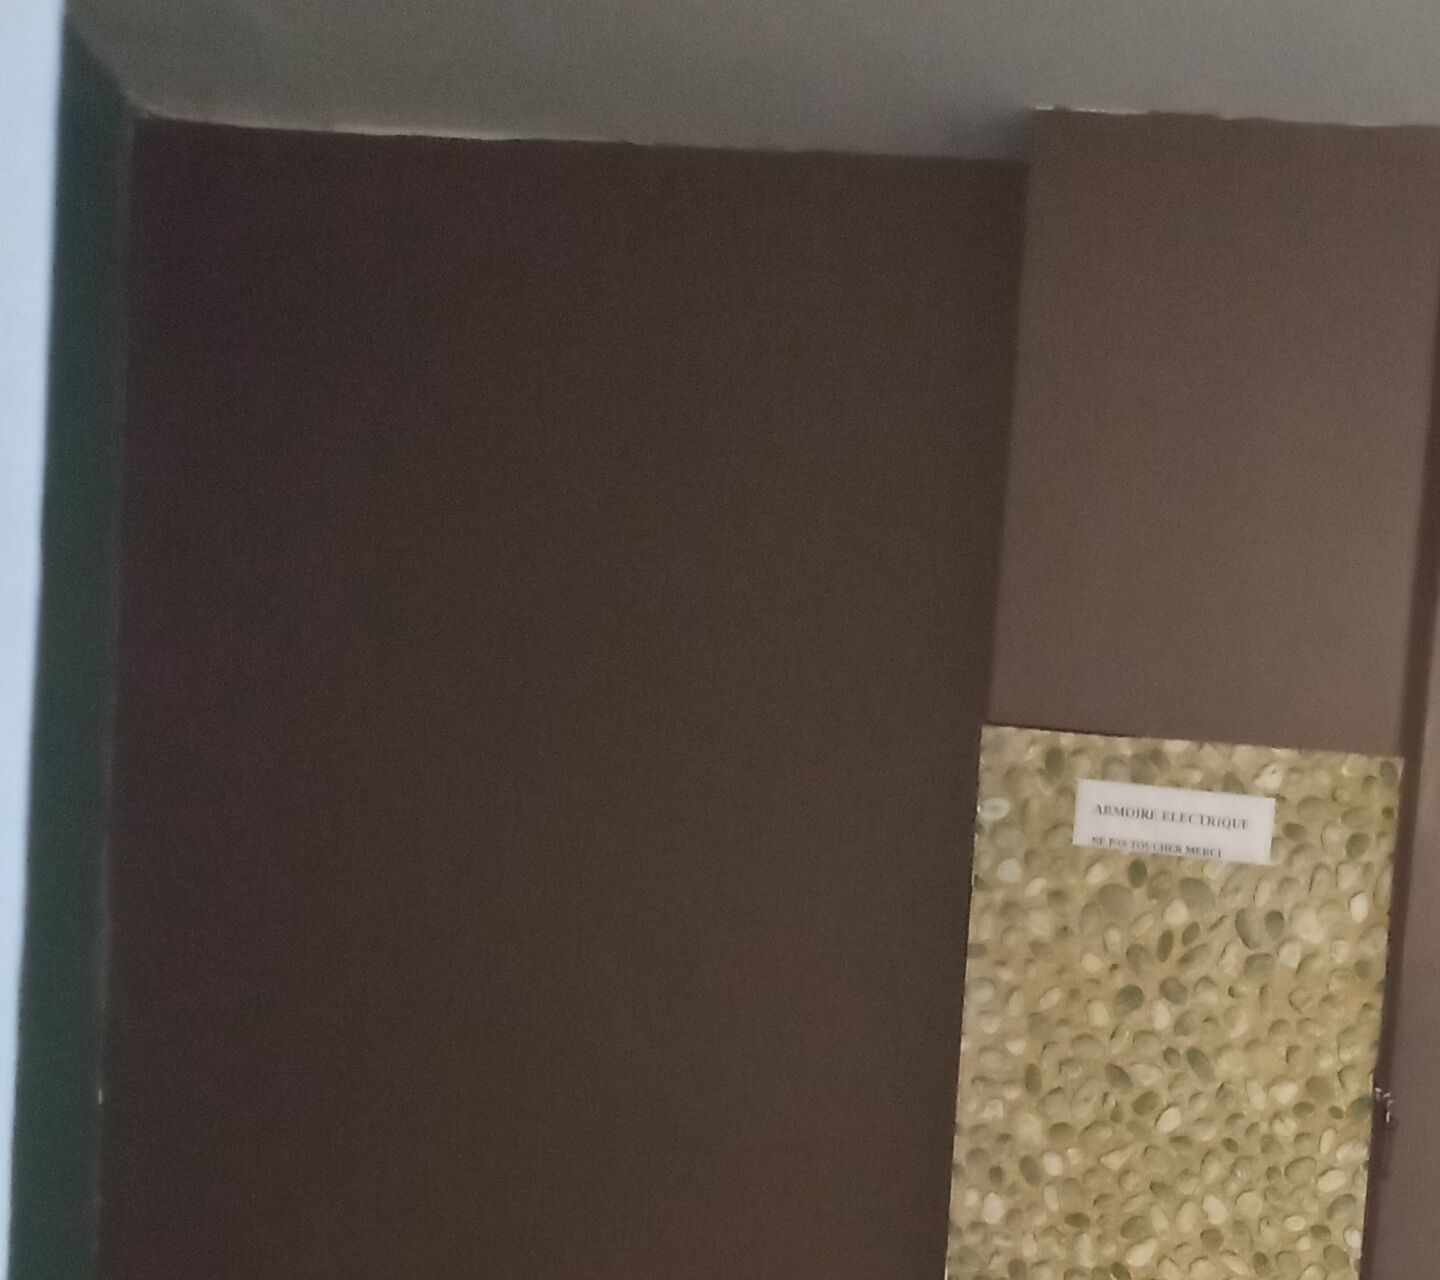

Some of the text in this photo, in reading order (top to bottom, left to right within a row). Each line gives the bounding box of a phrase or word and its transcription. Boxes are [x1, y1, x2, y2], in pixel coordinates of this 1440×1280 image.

[1096, 804, 1249, 830] ARMOIRE ELECTRIQUE
[1185, 845, 1222, 858] MERCI
